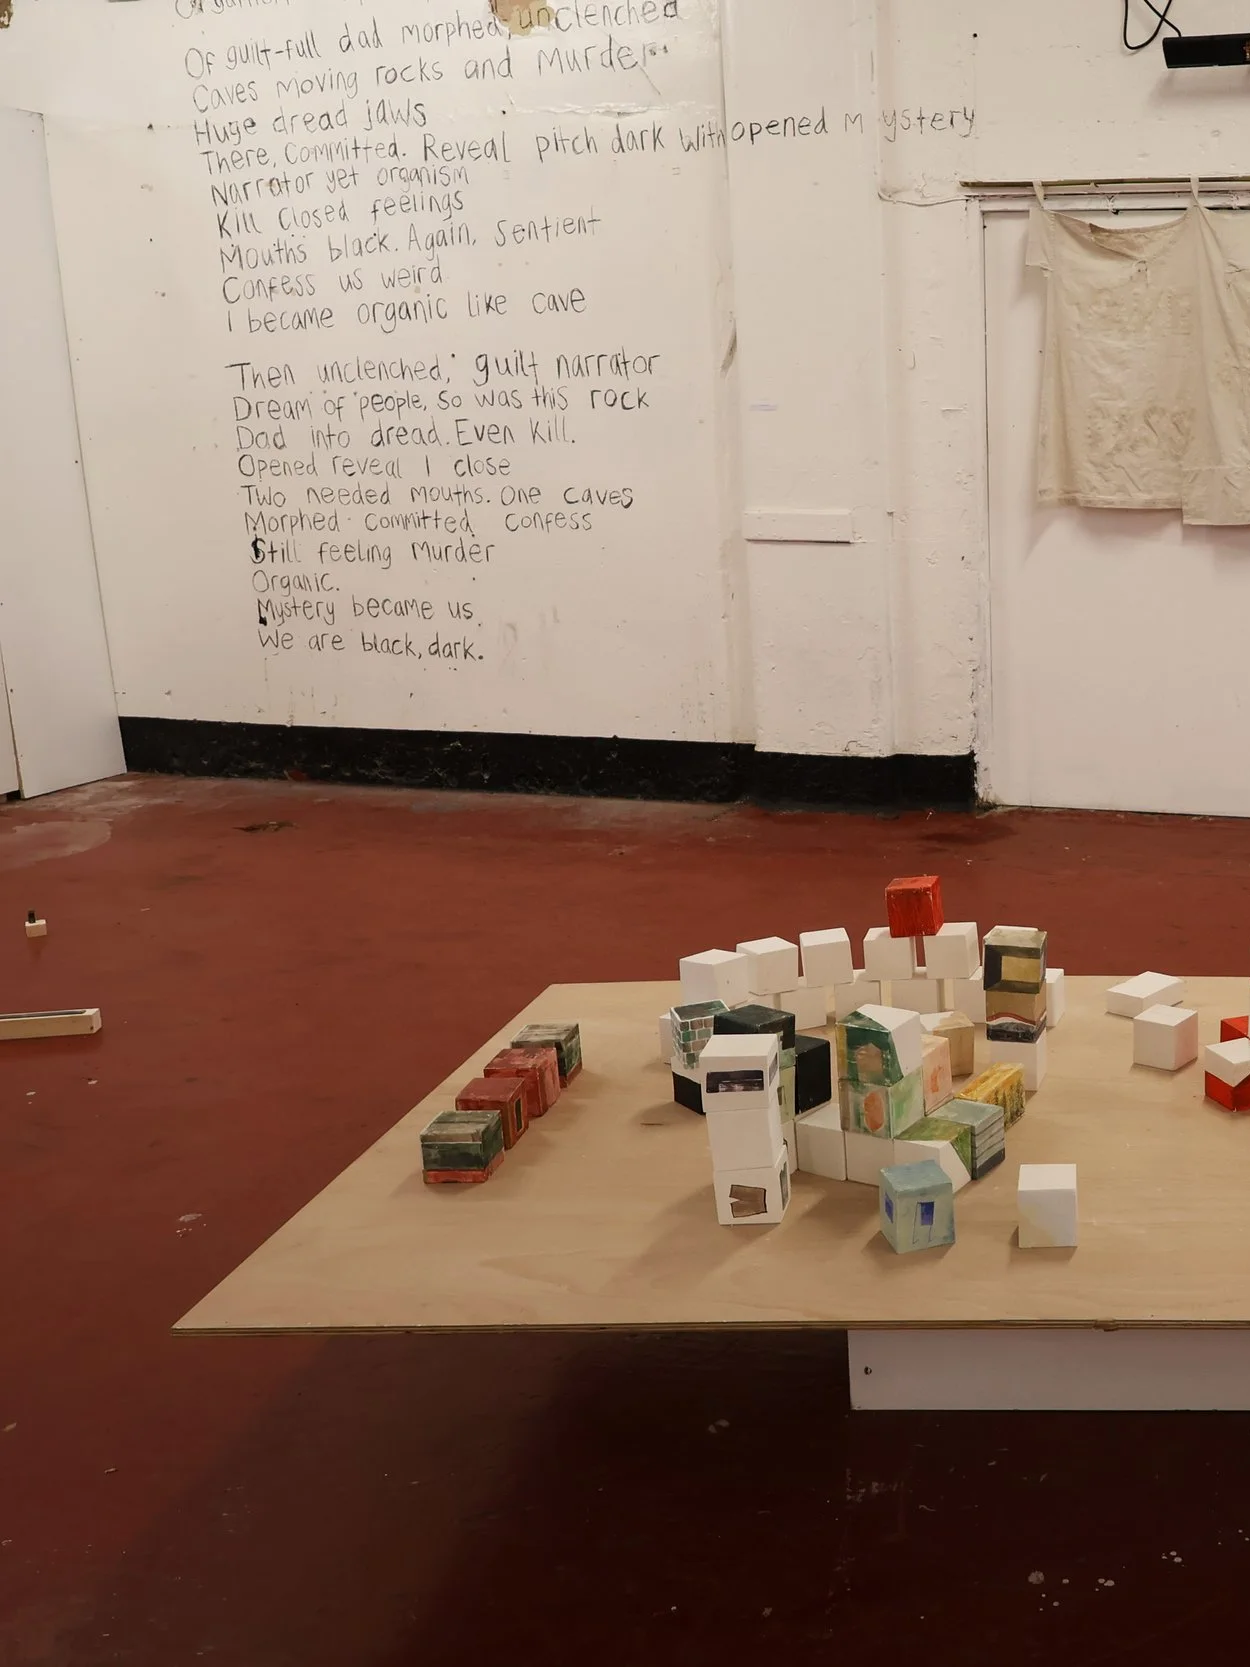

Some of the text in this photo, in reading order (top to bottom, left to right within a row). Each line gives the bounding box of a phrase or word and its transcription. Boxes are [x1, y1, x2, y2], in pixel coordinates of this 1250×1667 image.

[185, 48, 215, 79] Of
[339, 16, 382, 52] dad
[193, 81, 257, 113] Caves
[376, 57, 443, 86] rocks
[465, 44, 512, 79] and
[195, 117, 257, 146] Huge
[273, 100, 348, 134] dread
[423, 131, 511, 163] Reveal
[535, 126, 598, 163] pitch
[612, 121, 666, 154] dark
[731, 106, 828, 145] opened
[211, 164, 470, 207] Narrator yet organism
[217, 208, 262, 240] Kill
[371, 190, 464, 224] feelings
[220, 237, 307, 273] Mouths
[222, 255, 443, 304] Confess us weird
[227, 288, 587, 334] I became organic like cave
[224, 362, 296, 391] Then
[473, 350, 539, 387] guilt
[557, 346, 660, 381] narrator
[233, 396, 312, 421] Dream
[324, 395, 346, 422] of
[359, 390, 427, 421] people,
[475, 389, 523, 410] was
[531, 385, 569, 411] this
[590, 387, 650, 410] rock
[236, 423, 287, 450] Dad
[310, 423, 350, 450] into
[371, 416, 450, 447] dread.
[455, 418, 515, 446] Even
[238, 451, 318, 479] Opened
[332, 455, 403, 479] reveal
[453, 454, 511, 477] close
[306, 481, 391, 505] needed
[244, 508, 340, 536] Morphed
[250, 534, 301, 564] Still
[318, 539, 392, 570] feeling
[252, 569, 340, 597] Organic.
[257, 598, 335, 626] Mystery
[352, 594, 435, 620] became
[258, 629, 294, 650] We
[308, 633, 346, 652] are
[428, 631, 484, 661] dark.
